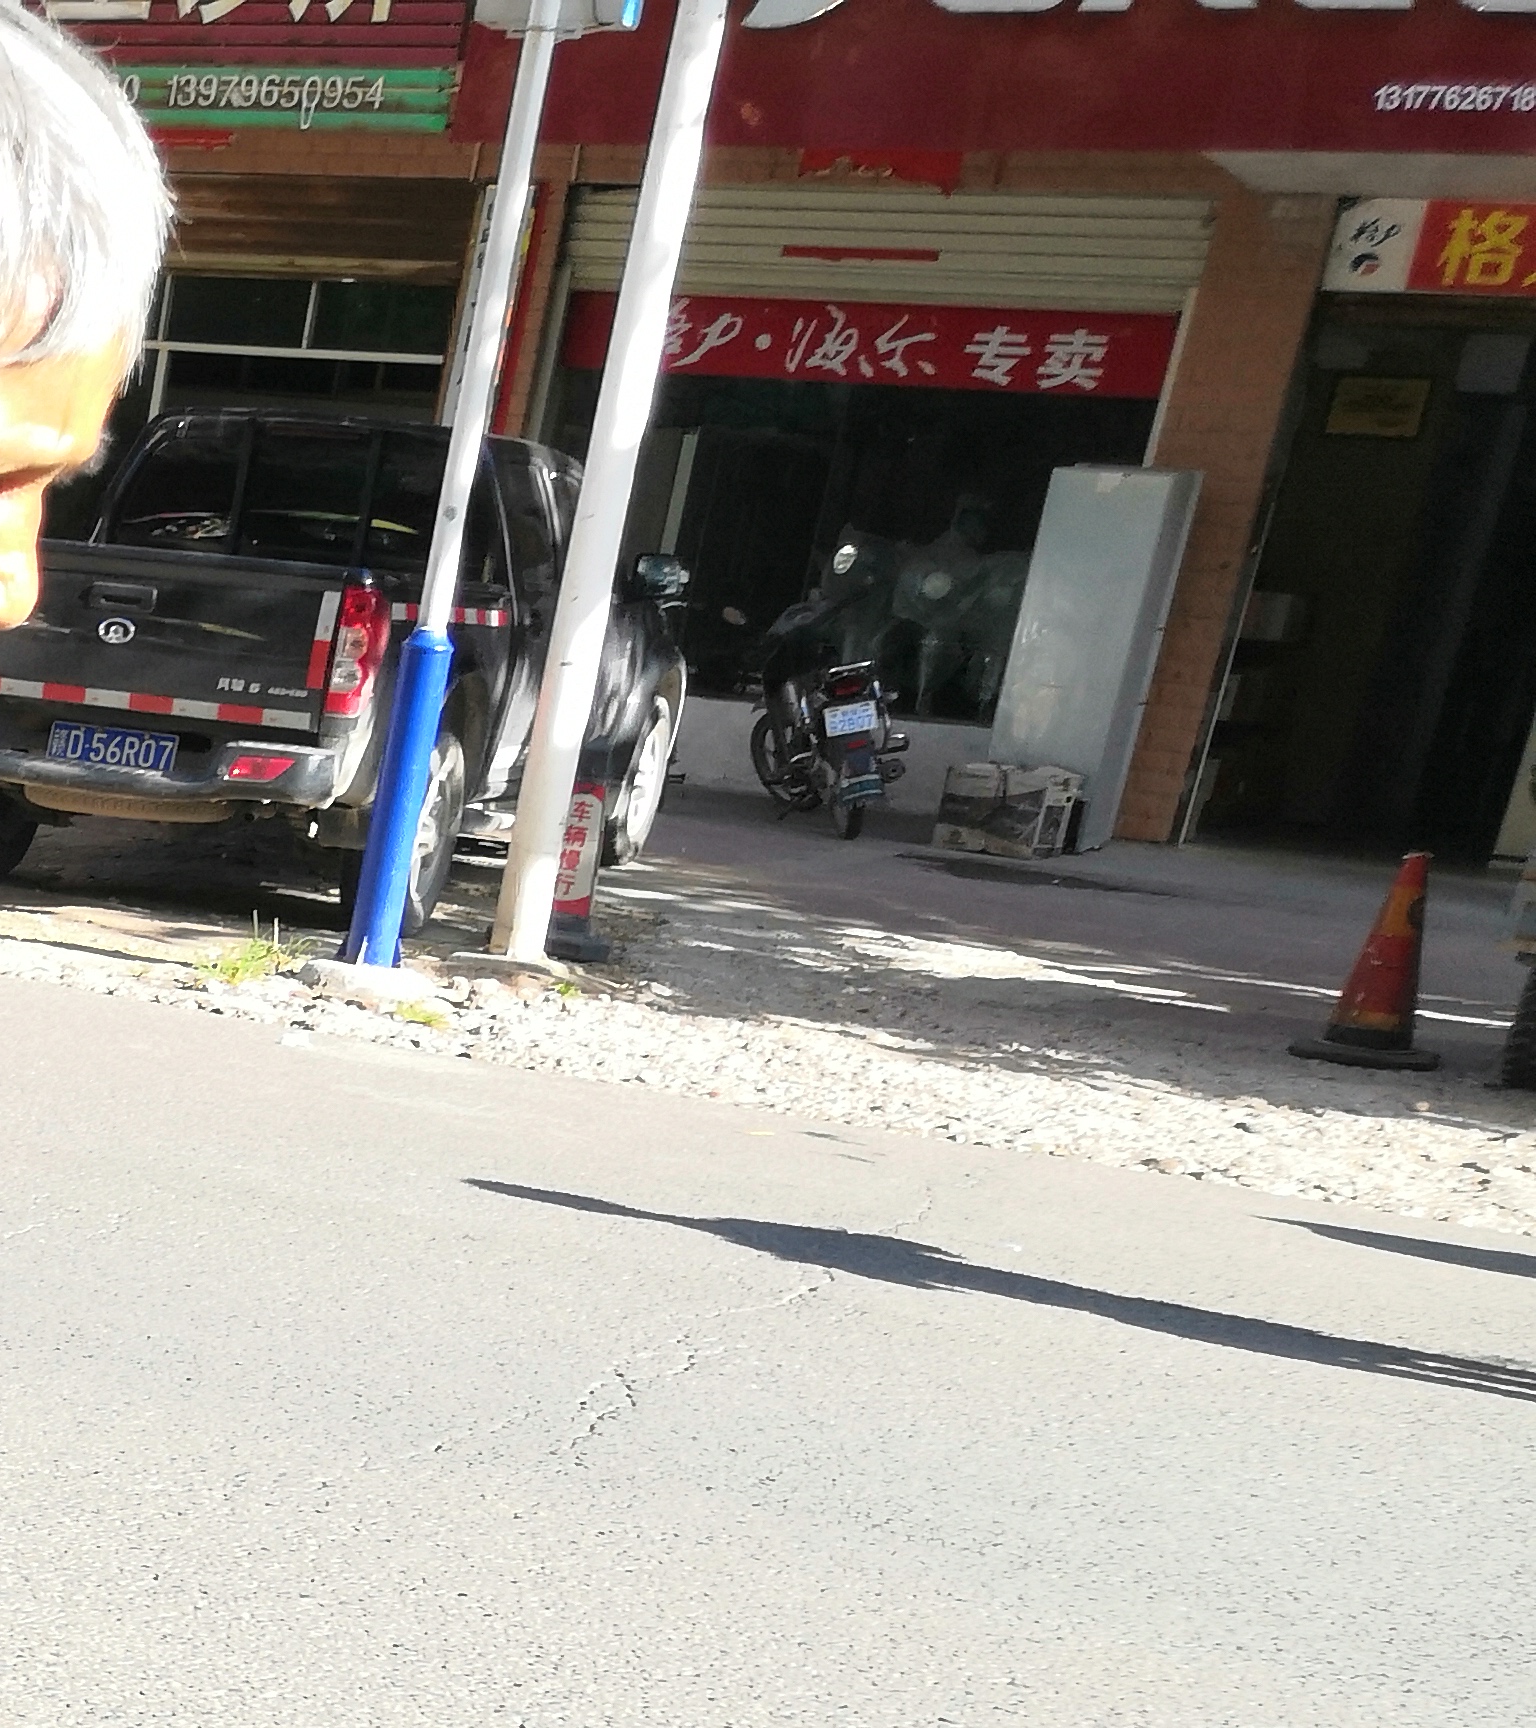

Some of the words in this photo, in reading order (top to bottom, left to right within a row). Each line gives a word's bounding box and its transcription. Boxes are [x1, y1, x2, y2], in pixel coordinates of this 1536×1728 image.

[165, 73, 387, 110] 13979650954
[1374, 83, 1536, 113] 13177626718
[1436, 208, 1536, 289] 格
[964, 324, 1111, 390] 专卖
[555, 800, 594, 896] 车辆慢行
